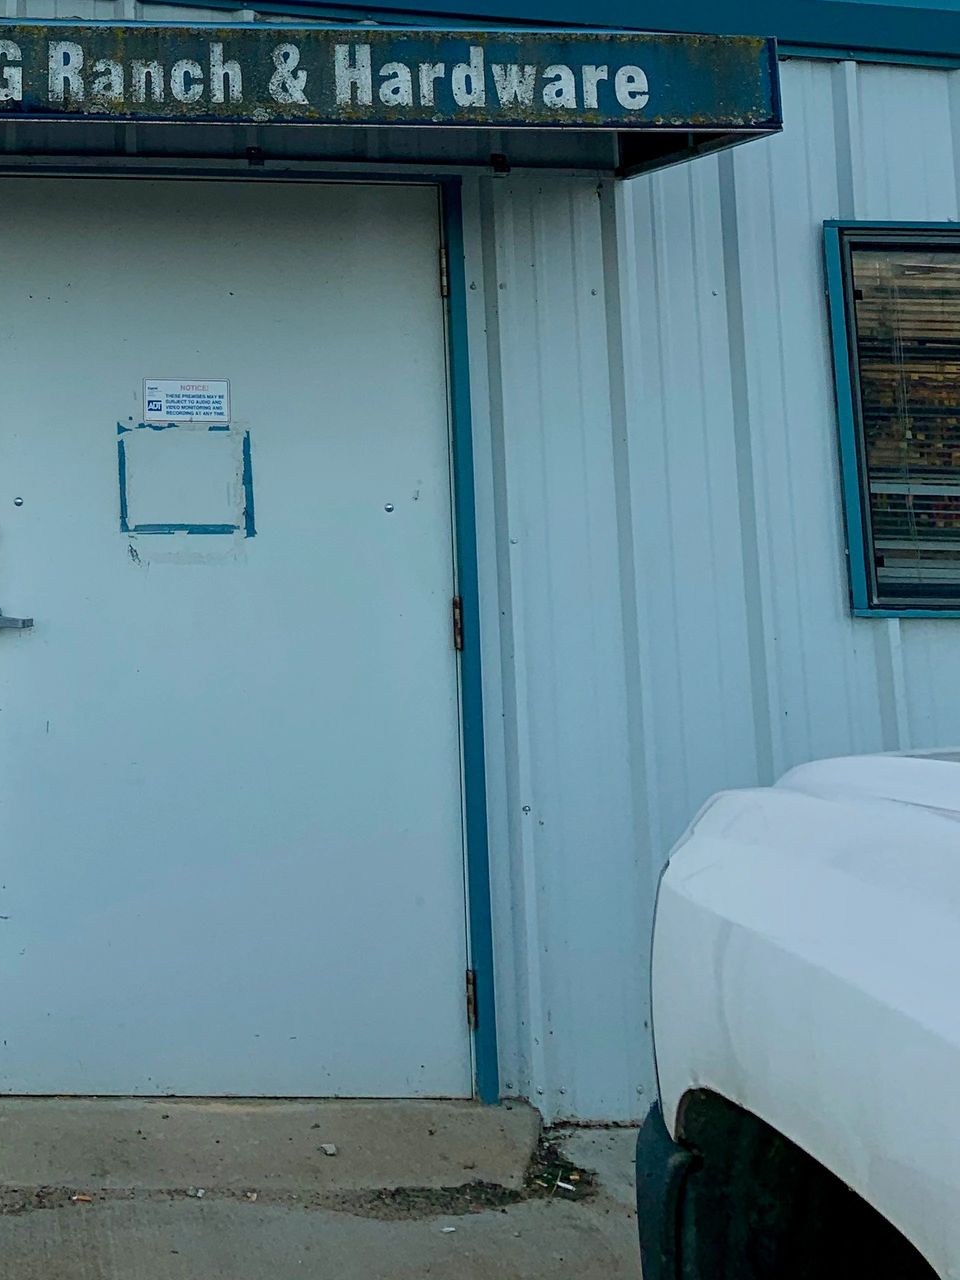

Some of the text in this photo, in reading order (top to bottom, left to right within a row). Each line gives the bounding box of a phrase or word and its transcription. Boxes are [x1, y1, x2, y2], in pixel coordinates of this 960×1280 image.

[48, 41, 241, 103] Ranch
[268, 43, 309, 105] &
[335, 44, 650, 110] Hardware
[148, 401, 162, 410] ADT
